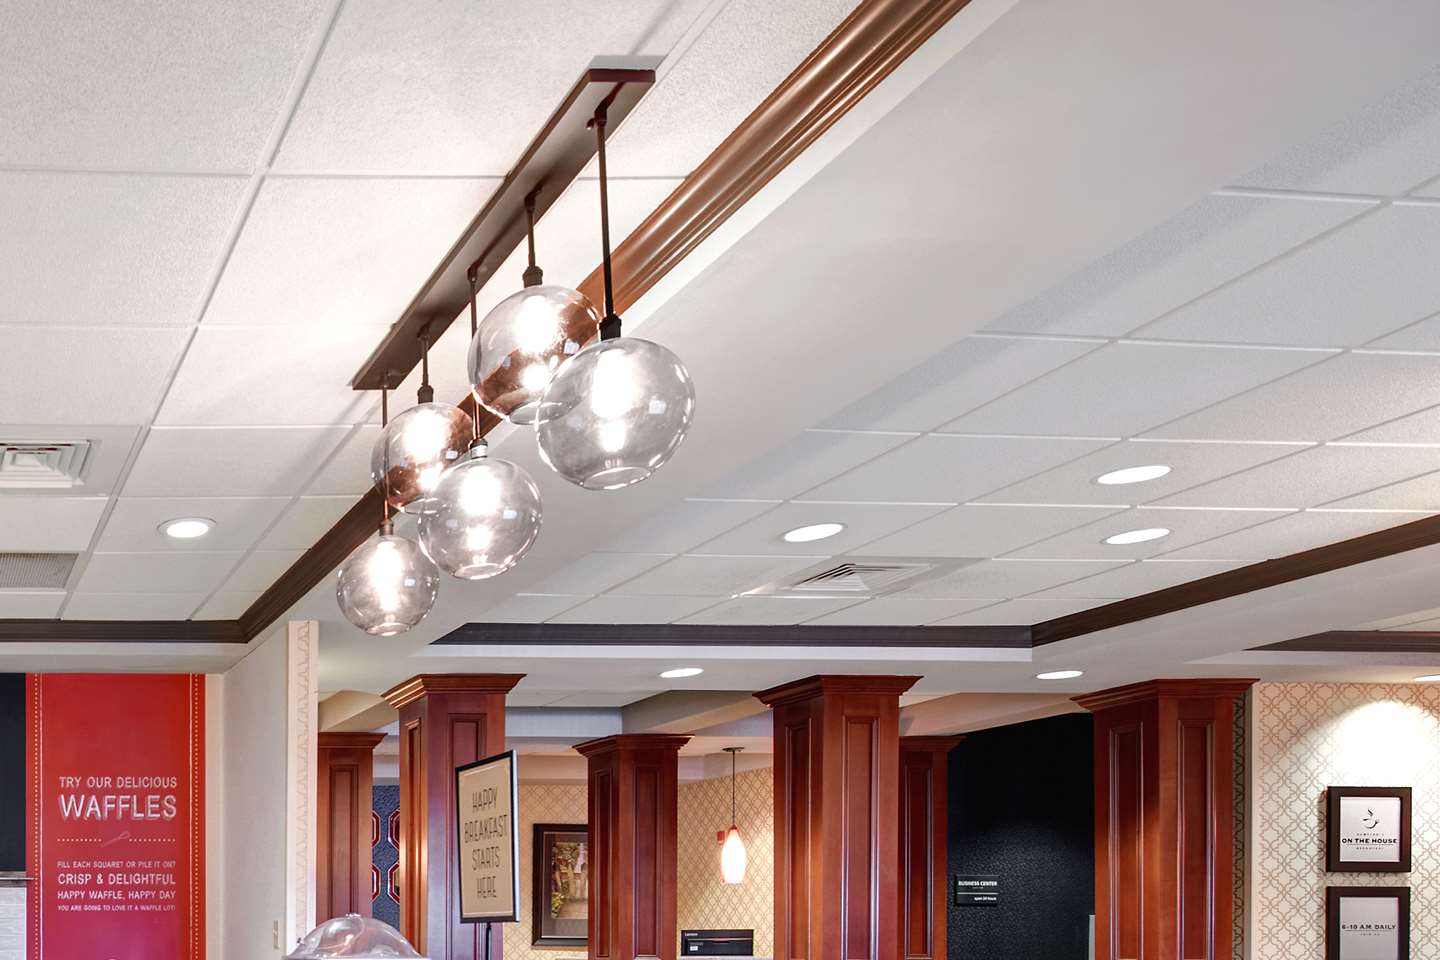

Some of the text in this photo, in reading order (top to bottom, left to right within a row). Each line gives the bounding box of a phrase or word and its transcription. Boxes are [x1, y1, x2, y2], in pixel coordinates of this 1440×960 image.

[59, 776, 177, 788] TRY OUR DELICIOUS
[59, 794, 177, 820] WAFFLES
[472, 787, 498, 812] HAPPY
[464, 814, 508, 843] BREAKFAST
[472, 846, 500, 871] STARTS
[58, 874, 176, 884] CRISP & DELIGHTFUL
[477, 876, 496, 899] HERE
[58, 890, 85, 900] HAPPY
[128, 890, 156, 900] HAPPY
[160, 890, 176, 900] DAY
